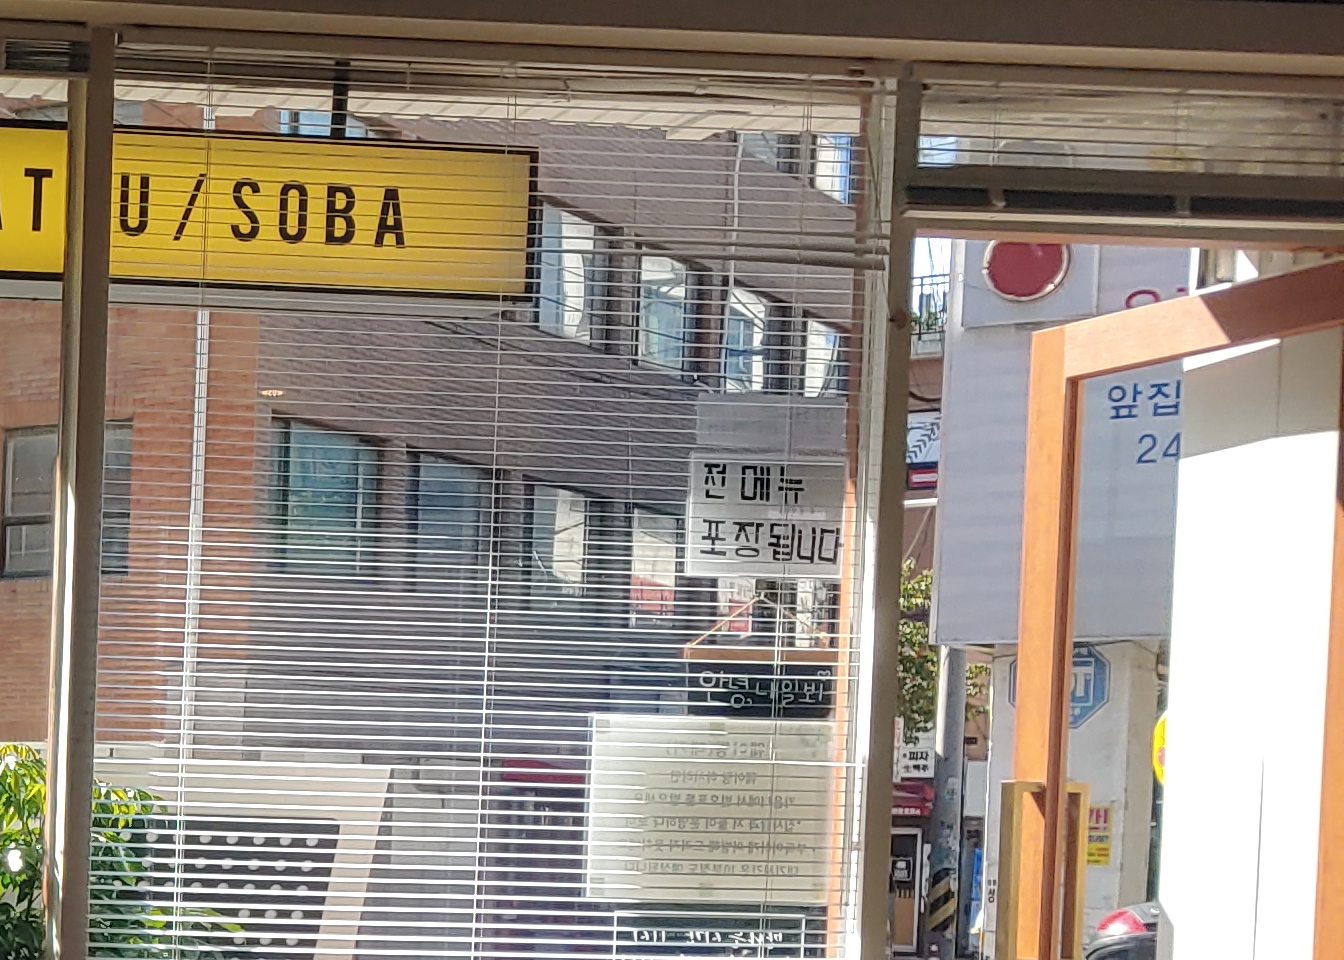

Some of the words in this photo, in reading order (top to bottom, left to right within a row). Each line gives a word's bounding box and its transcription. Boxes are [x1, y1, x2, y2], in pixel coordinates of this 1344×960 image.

[1107, 379, 1182, 420] 앞집
[704, 463, 727, 499] 전
[740, 465, 805, 504] 메뉴
[700, 519, 843, 564] 포장됩니다
[909, 751, 929, 761] 피자
